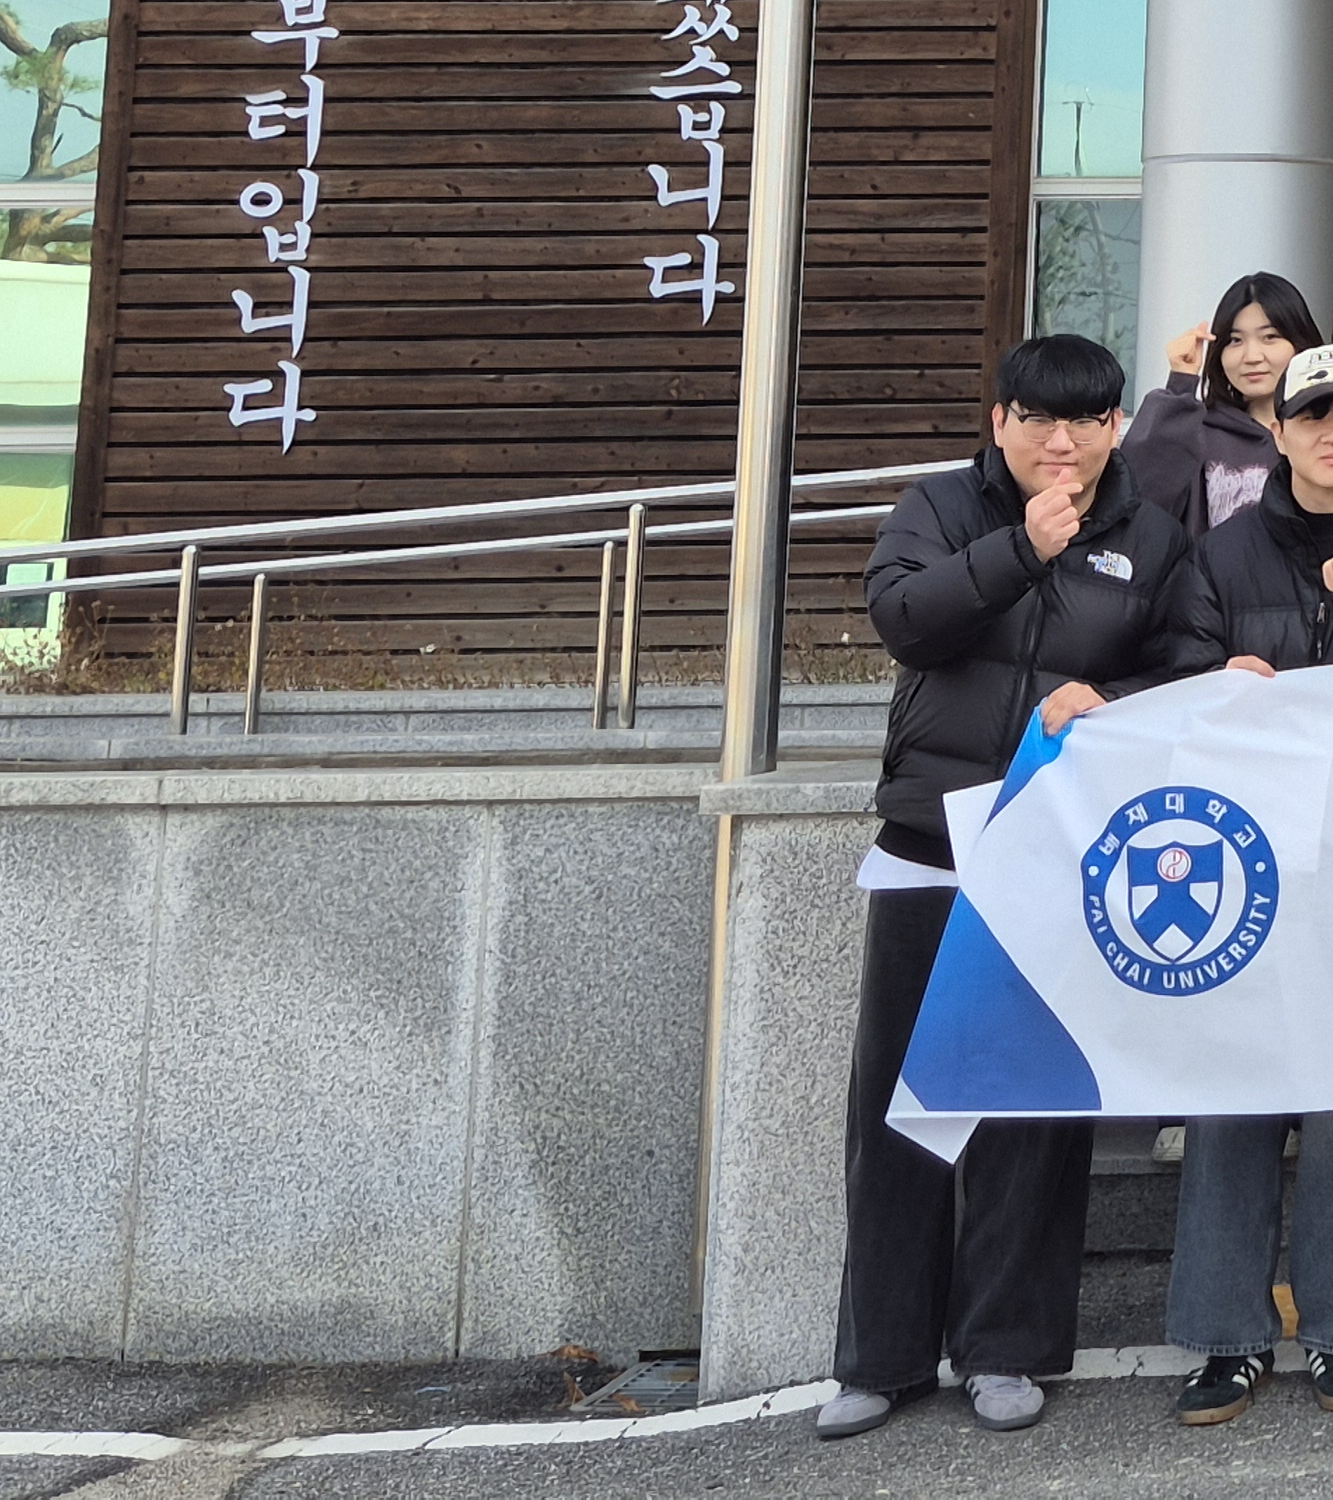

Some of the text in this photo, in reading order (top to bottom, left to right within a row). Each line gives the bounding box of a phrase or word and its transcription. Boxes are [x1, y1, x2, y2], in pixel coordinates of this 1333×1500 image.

[1088, 892, 1271, 989] PAI CHAI UNIVERSITY
